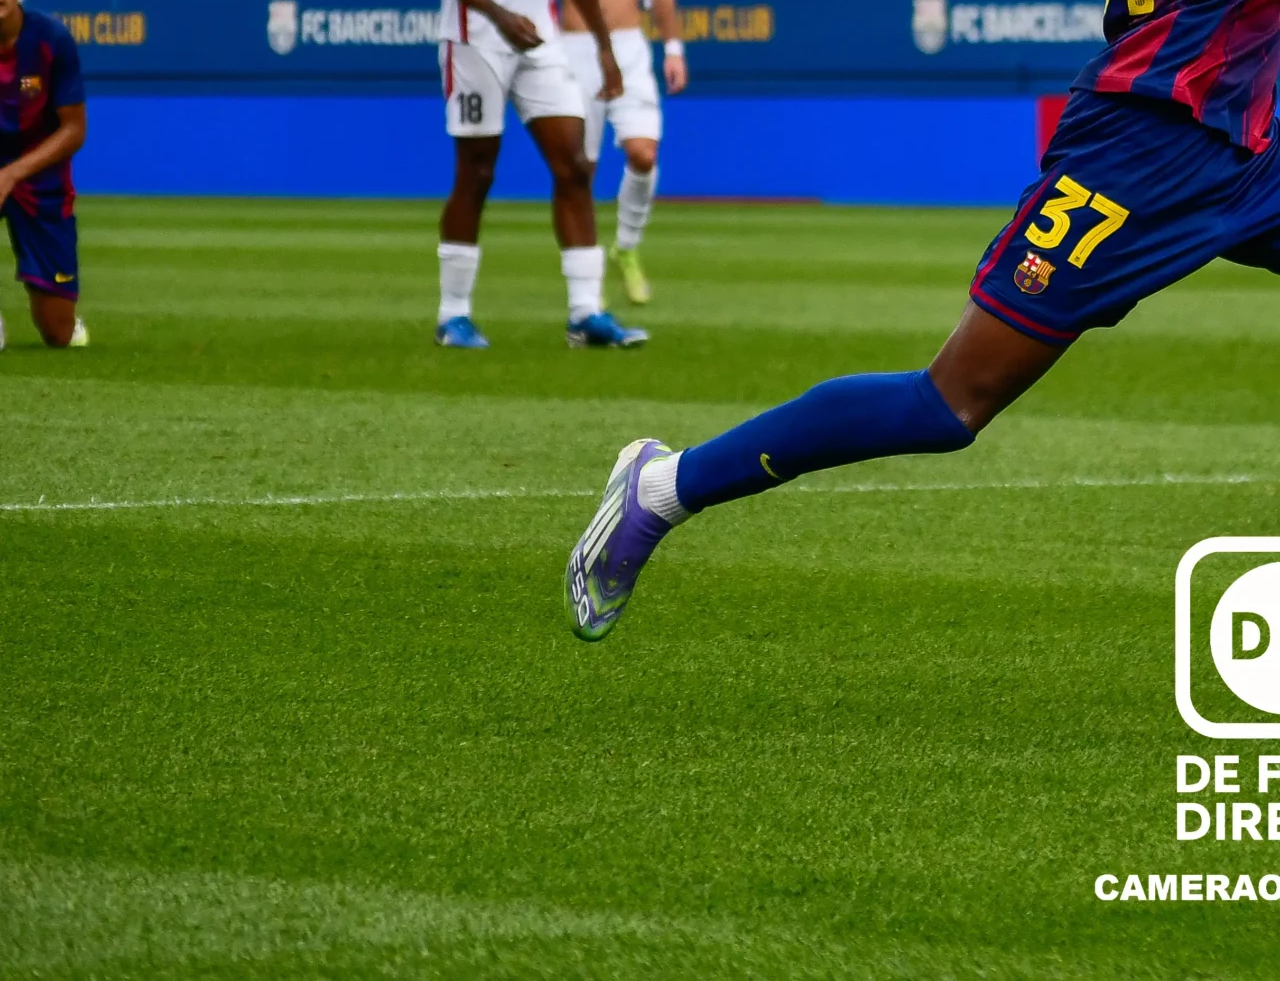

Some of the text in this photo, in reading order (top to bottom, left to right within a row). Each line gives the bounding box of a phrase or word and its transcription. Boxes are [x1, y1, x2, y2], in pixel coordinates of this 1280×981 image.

[94, 12, 147, 45] CLUB
[302, 9, 327, 45] FC
[713, 4, 775, 42] CLUB
[951, 4, 981, 43] FC
[456, 91, 483, 125] 18
[1024, 174, 1131, 270] 37
